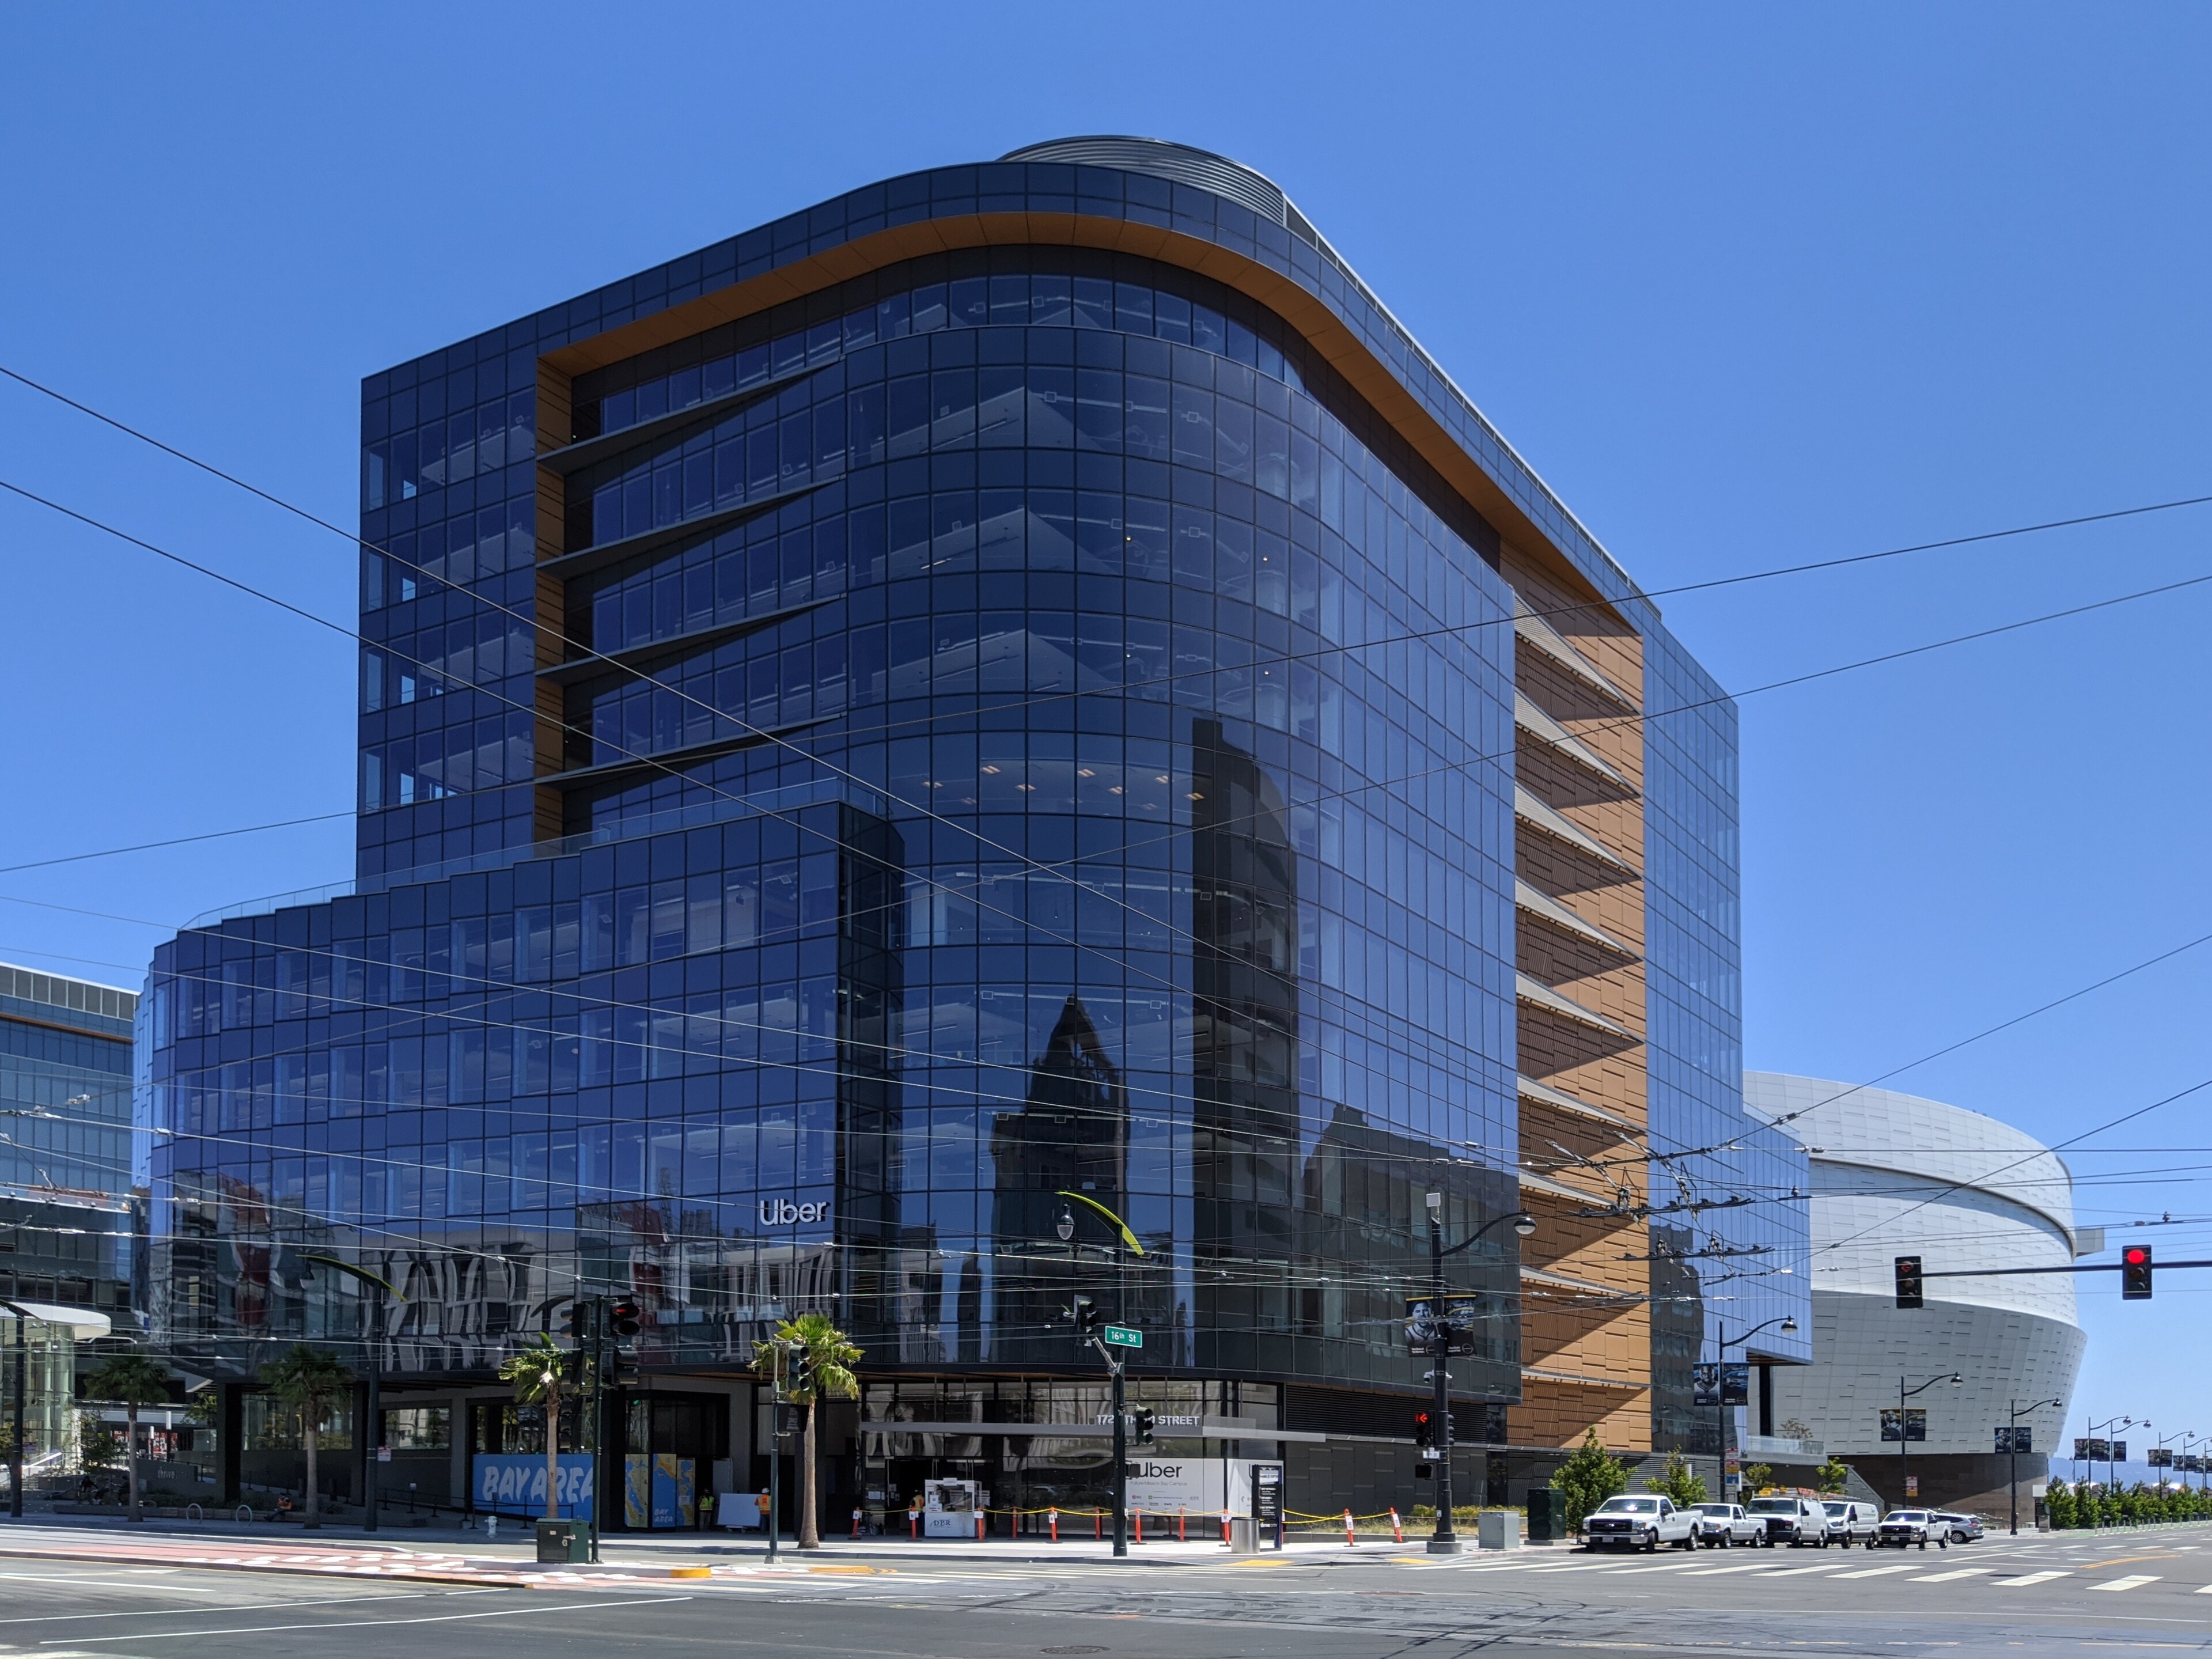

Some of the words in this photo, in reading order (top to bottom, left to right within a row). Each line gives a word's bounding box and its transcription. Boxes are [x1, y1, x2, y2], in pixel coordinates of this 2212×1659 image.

[760, 1198, 827, 1226] Uber
[1111, 1331, 1125, 1340] 16th
[1128, 1334, 1137, 1343] St
[1096, 1414, 1115, 1425] 172
[1158, 1415, 1200, 1426] STREET
[482, 1466, 531, 1501] BAY
